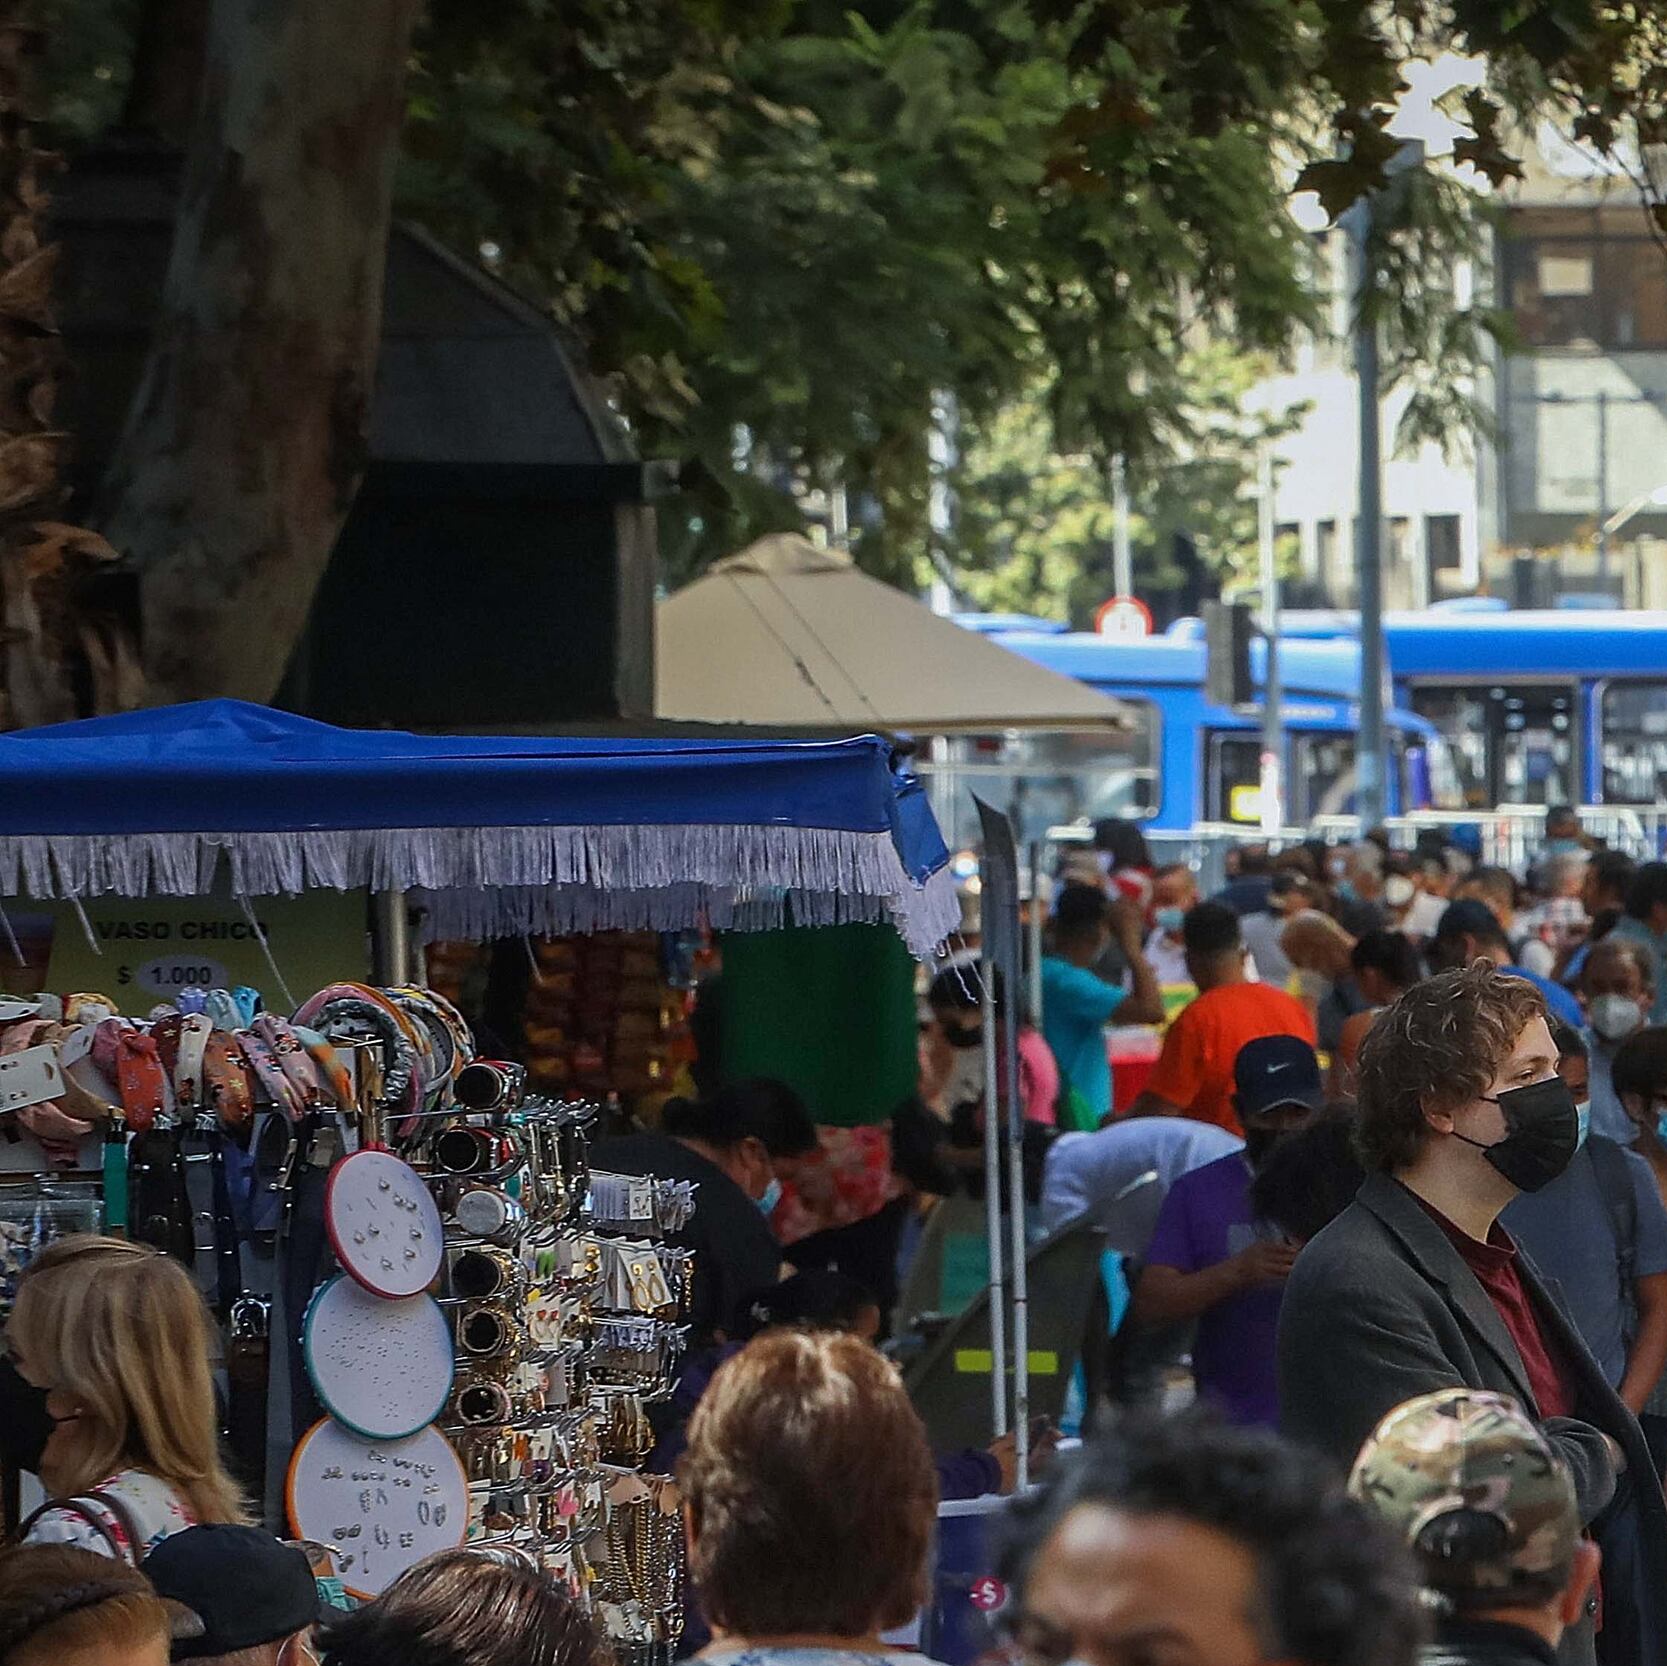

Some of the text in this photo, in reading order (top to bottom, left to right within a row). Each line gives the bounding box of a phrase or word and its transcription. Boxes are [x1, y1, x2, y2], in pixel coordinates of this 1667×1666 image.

[98, 921, 268, 941] VASO CHICO
[117, 966, 213, 985] $ 1.000
